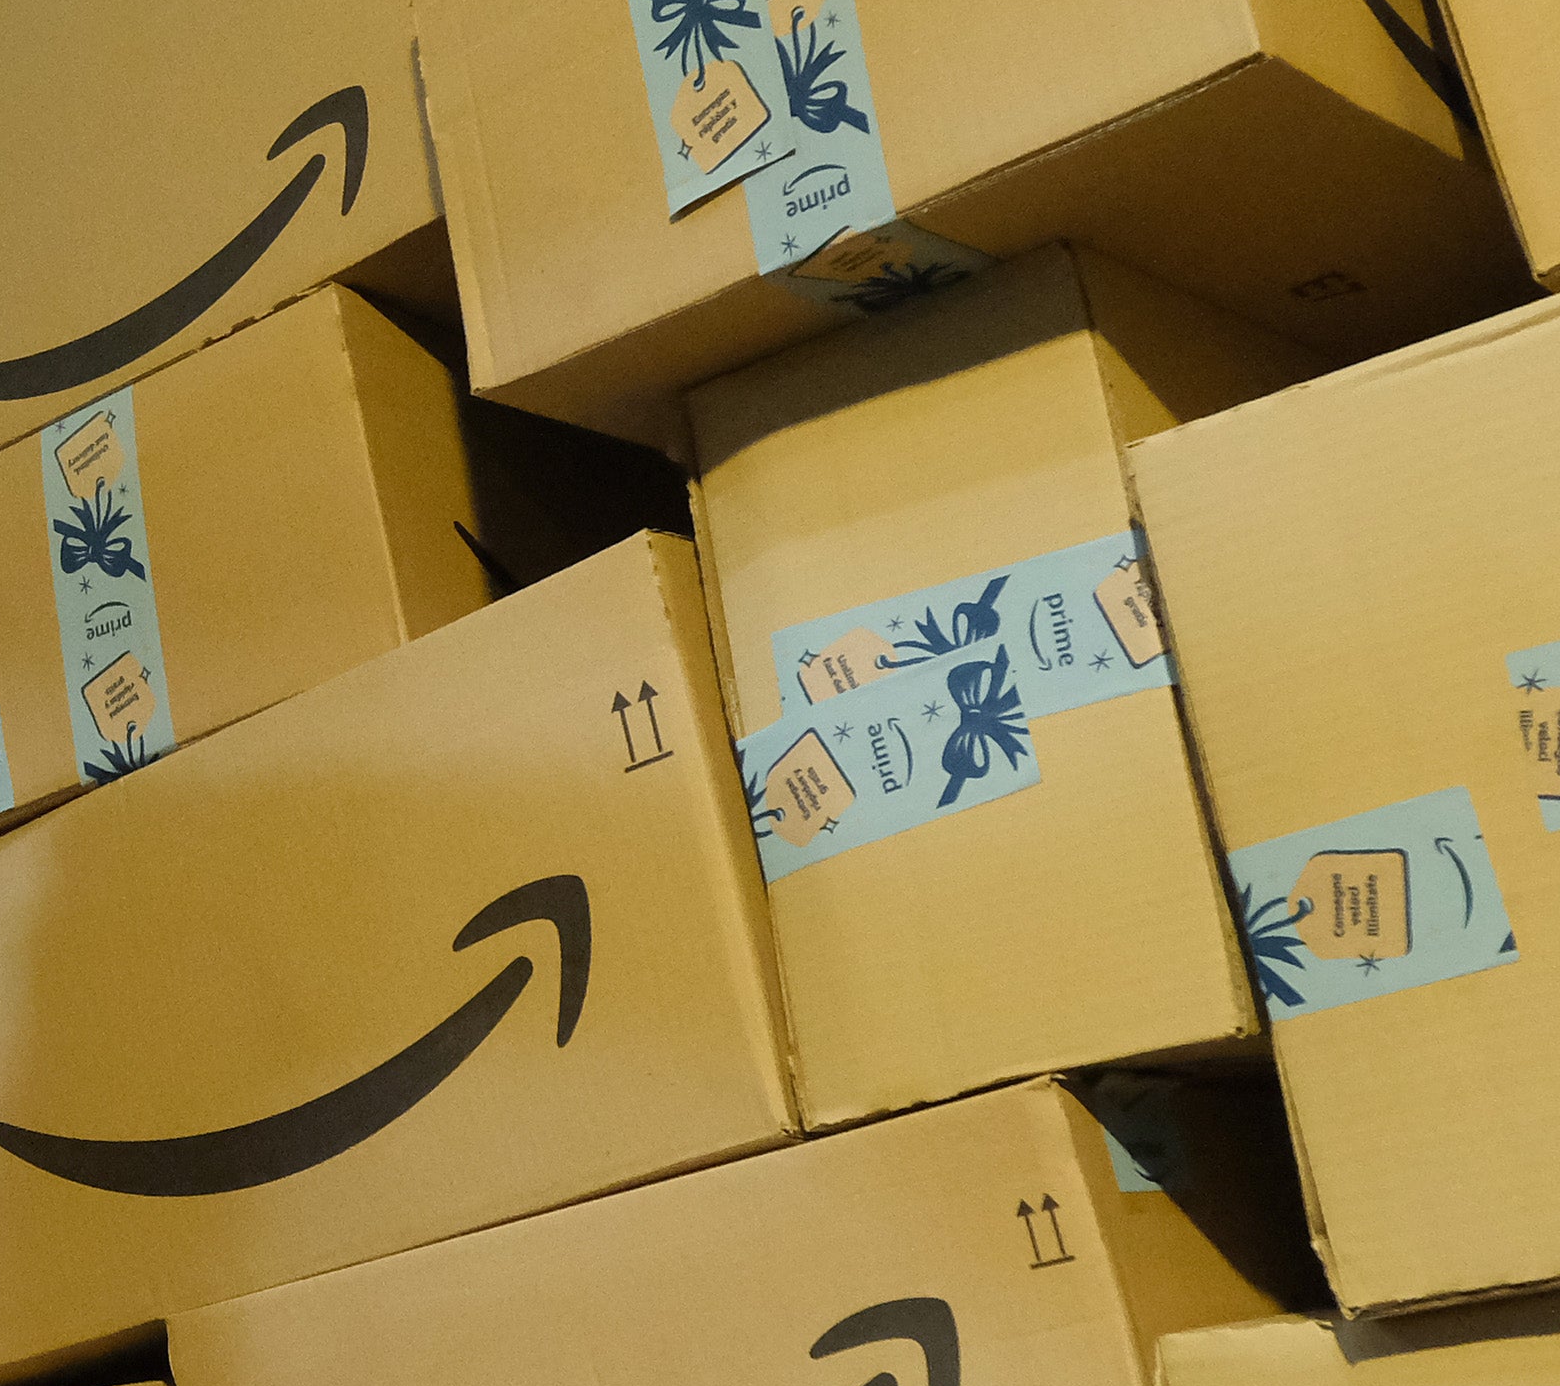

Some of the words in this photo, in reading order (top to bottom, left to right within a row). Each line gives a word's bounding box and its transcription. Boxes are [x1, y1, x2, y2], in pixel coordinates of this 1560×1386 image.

[785, 173, 852, 218] prime
[86, 610, 132, 641] prime
[1042, 593, 1075, 668] prime
[868, 722, 904, 795] prime
[1537, 720, 1553, 762] veloci
[1331, 873, 1346, 938] Consegne
[1347, 886, 1362, 927] veloci
[1364, 873, 1380, 937] illimitate
